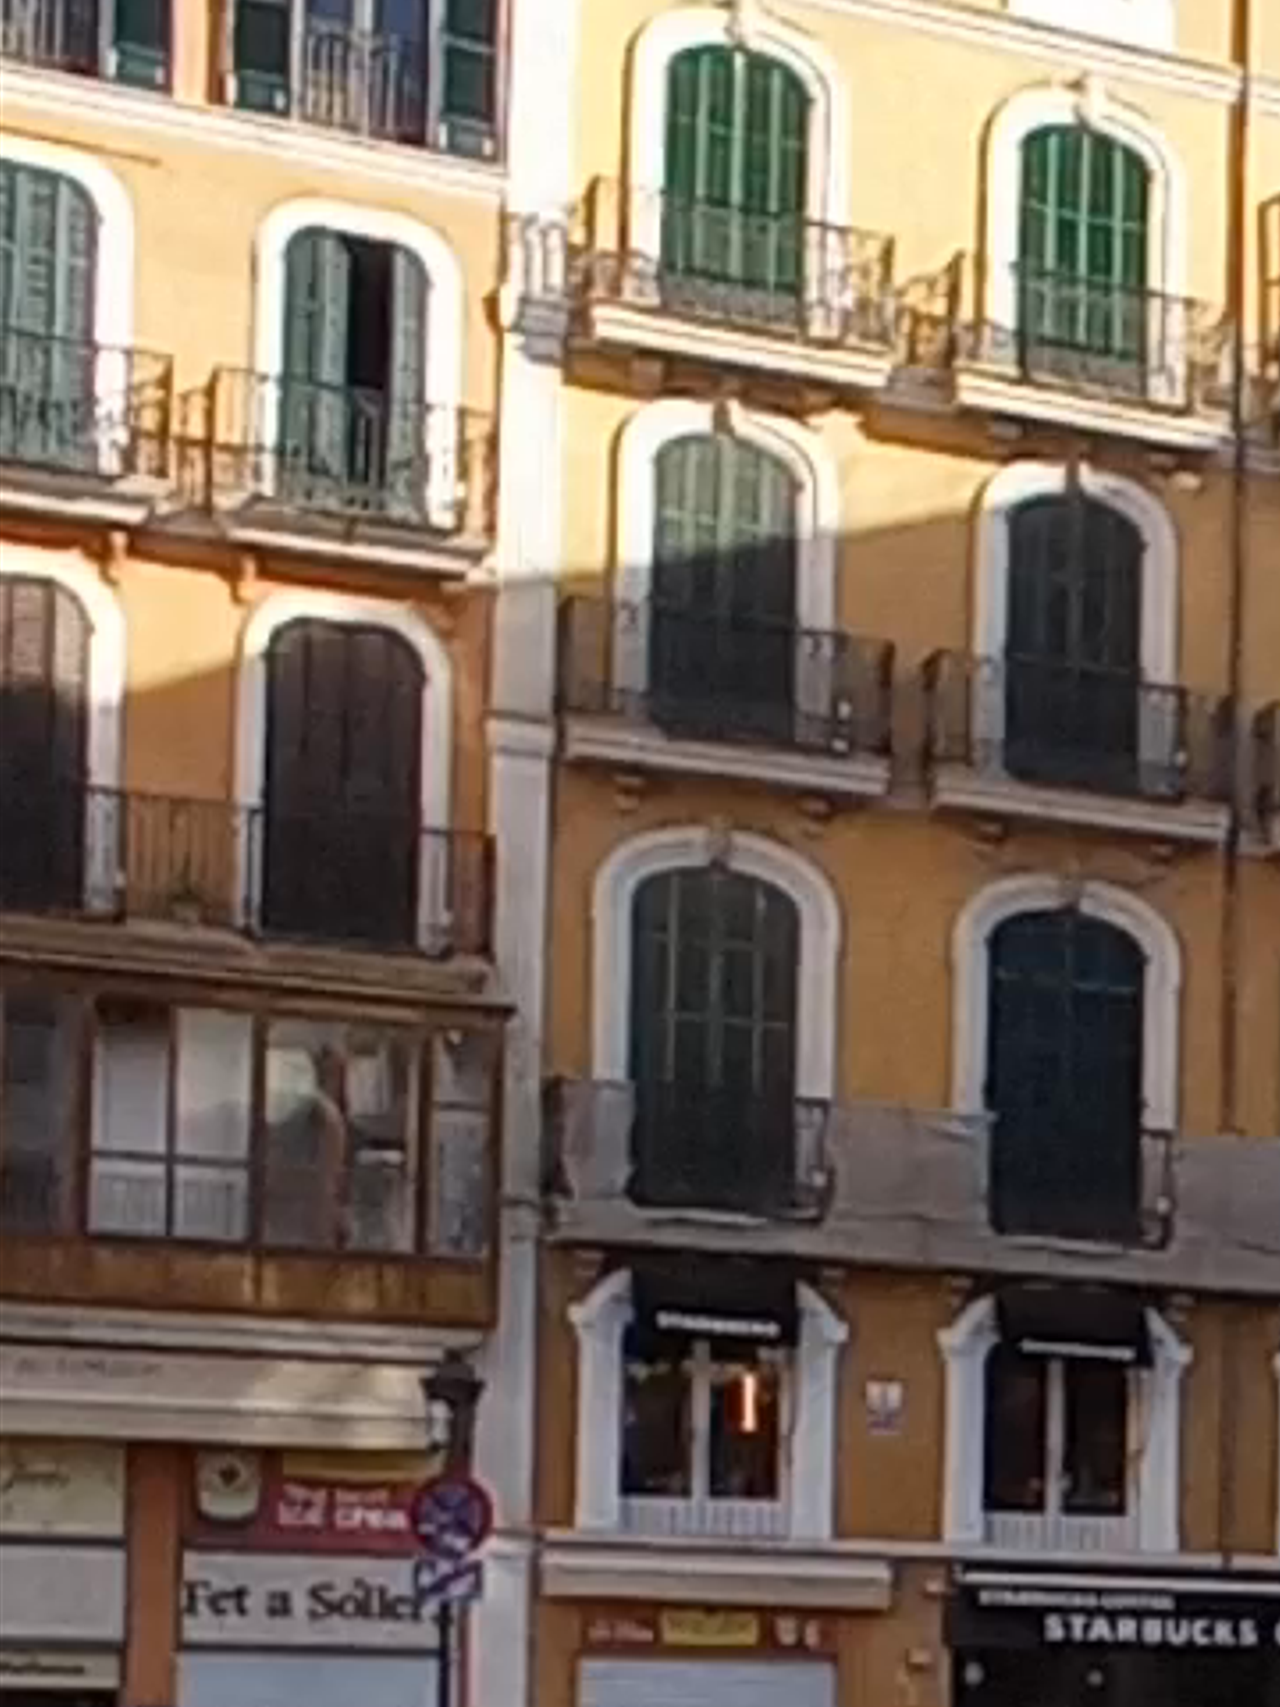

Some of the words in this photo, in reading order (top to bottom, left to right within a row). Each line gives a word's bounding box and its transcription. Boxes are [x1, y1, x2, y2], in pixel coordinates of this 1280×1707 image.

[184, 1579, 249, 1618] Fet
[265, 1590, 292, 1619] a
[1043, 1613, 1258, 1646] STARBUCKS
